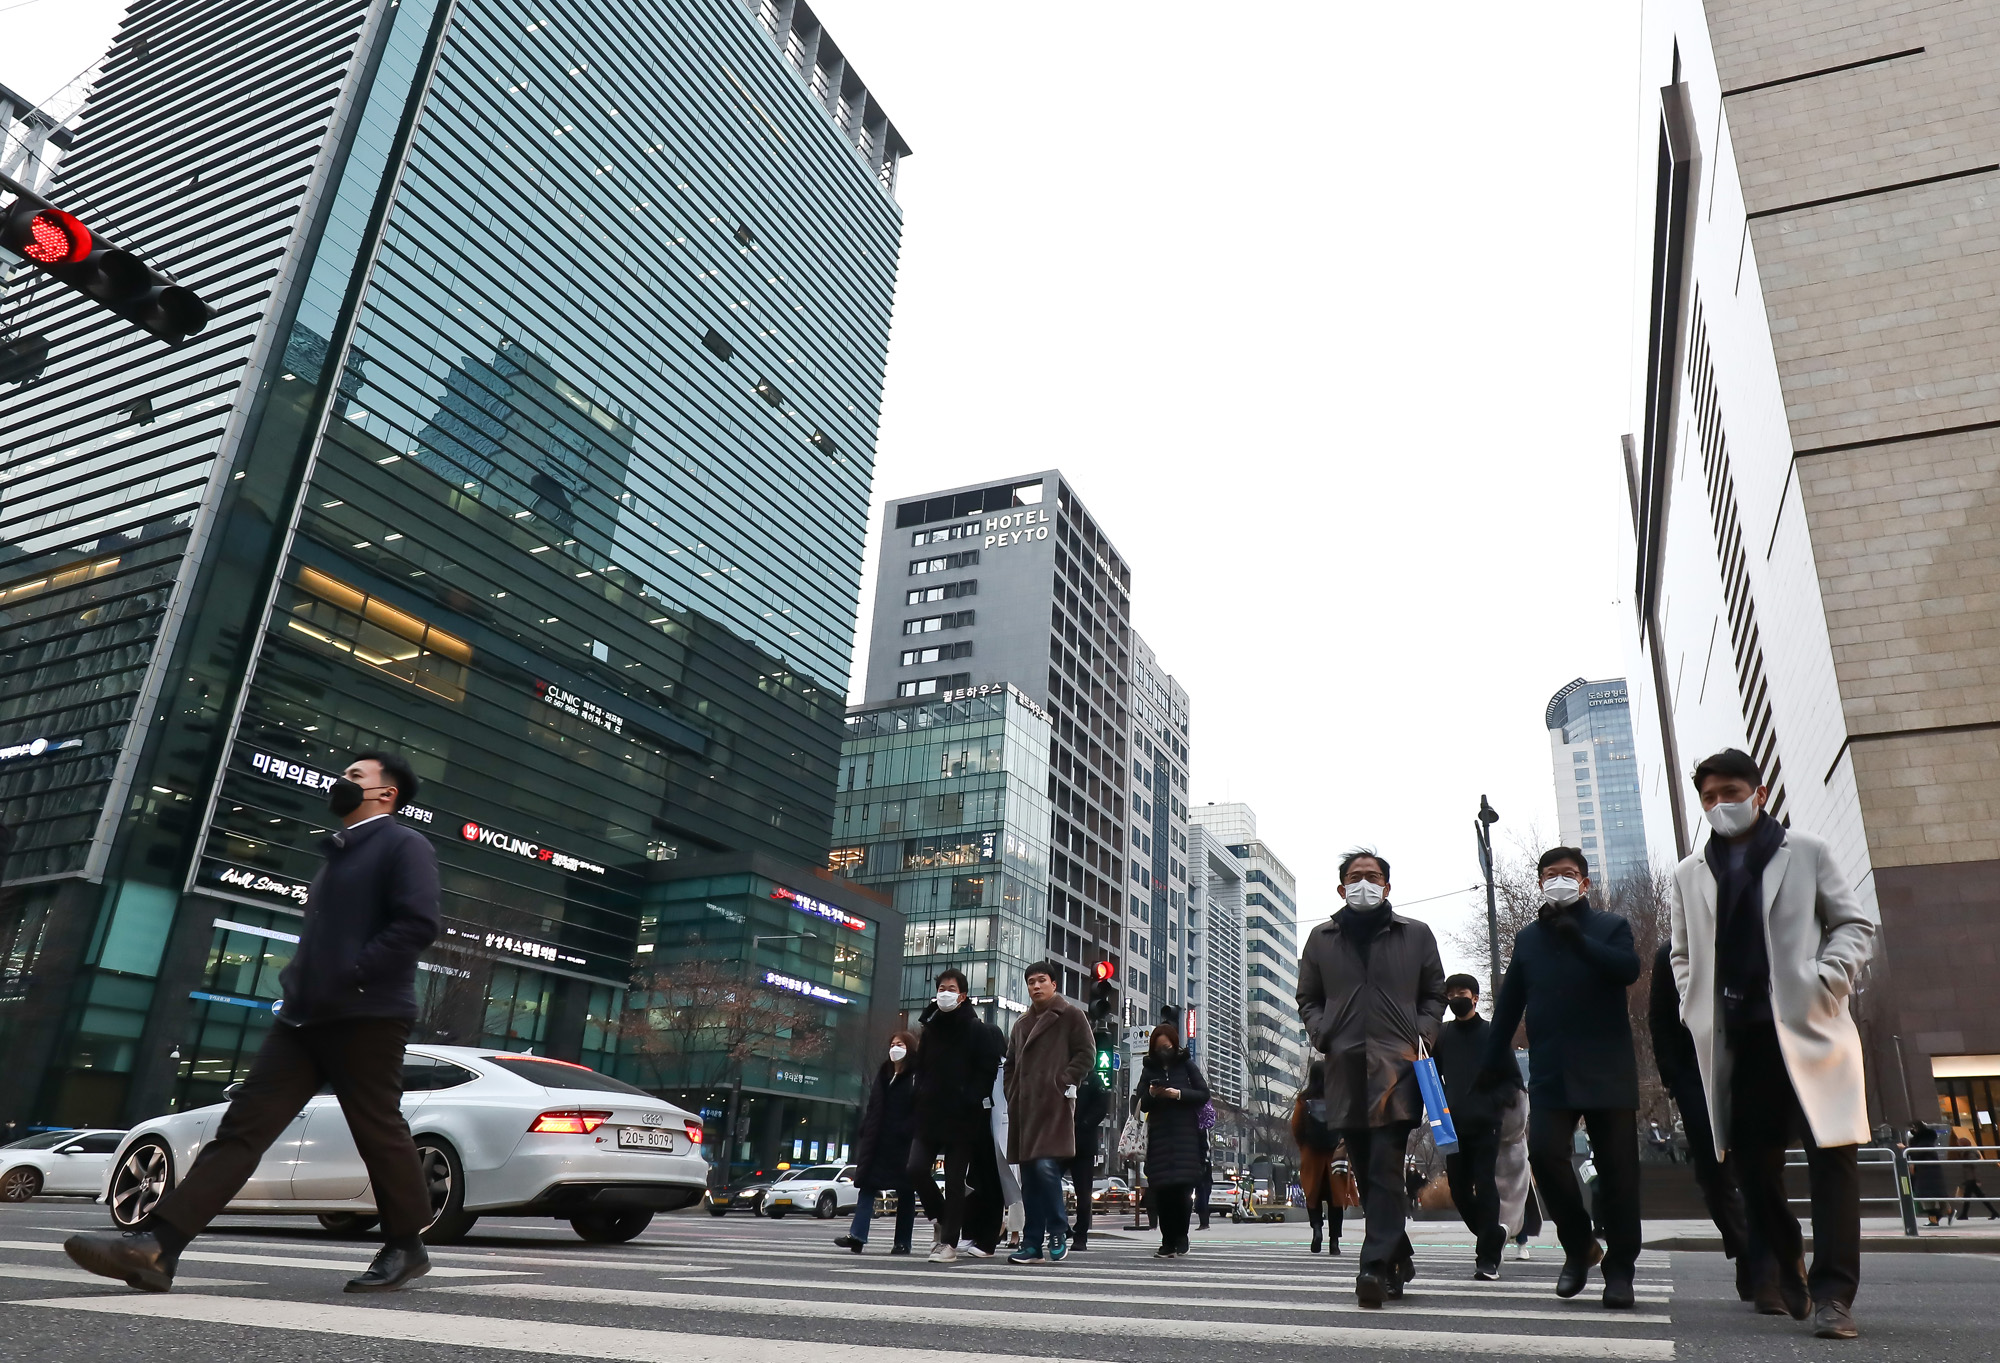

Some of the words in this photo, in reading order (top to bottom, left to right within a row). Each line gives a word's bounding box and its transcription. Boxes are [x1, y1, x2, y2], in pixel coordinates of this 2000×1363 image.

[986, 509, 1049, 531] HOTEL
[984, 527, 1048, 549] PEYTO
[548, 685, 580, 708] CLINIC
[1588, 689, 1627, 699] 도심공항타
[252, 752, 337, 793] 미래의료재
[479, 828, 538, 859] WCLINIC
[538, 849, 554, 861] 5F
[982, 836, 993, 859] 치과
[220, 868, 255, 889] Wall
[253, 876, 291, 896] Street
[784, 1071, 804, 1084] 우리은행
[648, 1133, 669, 1146] 8079
